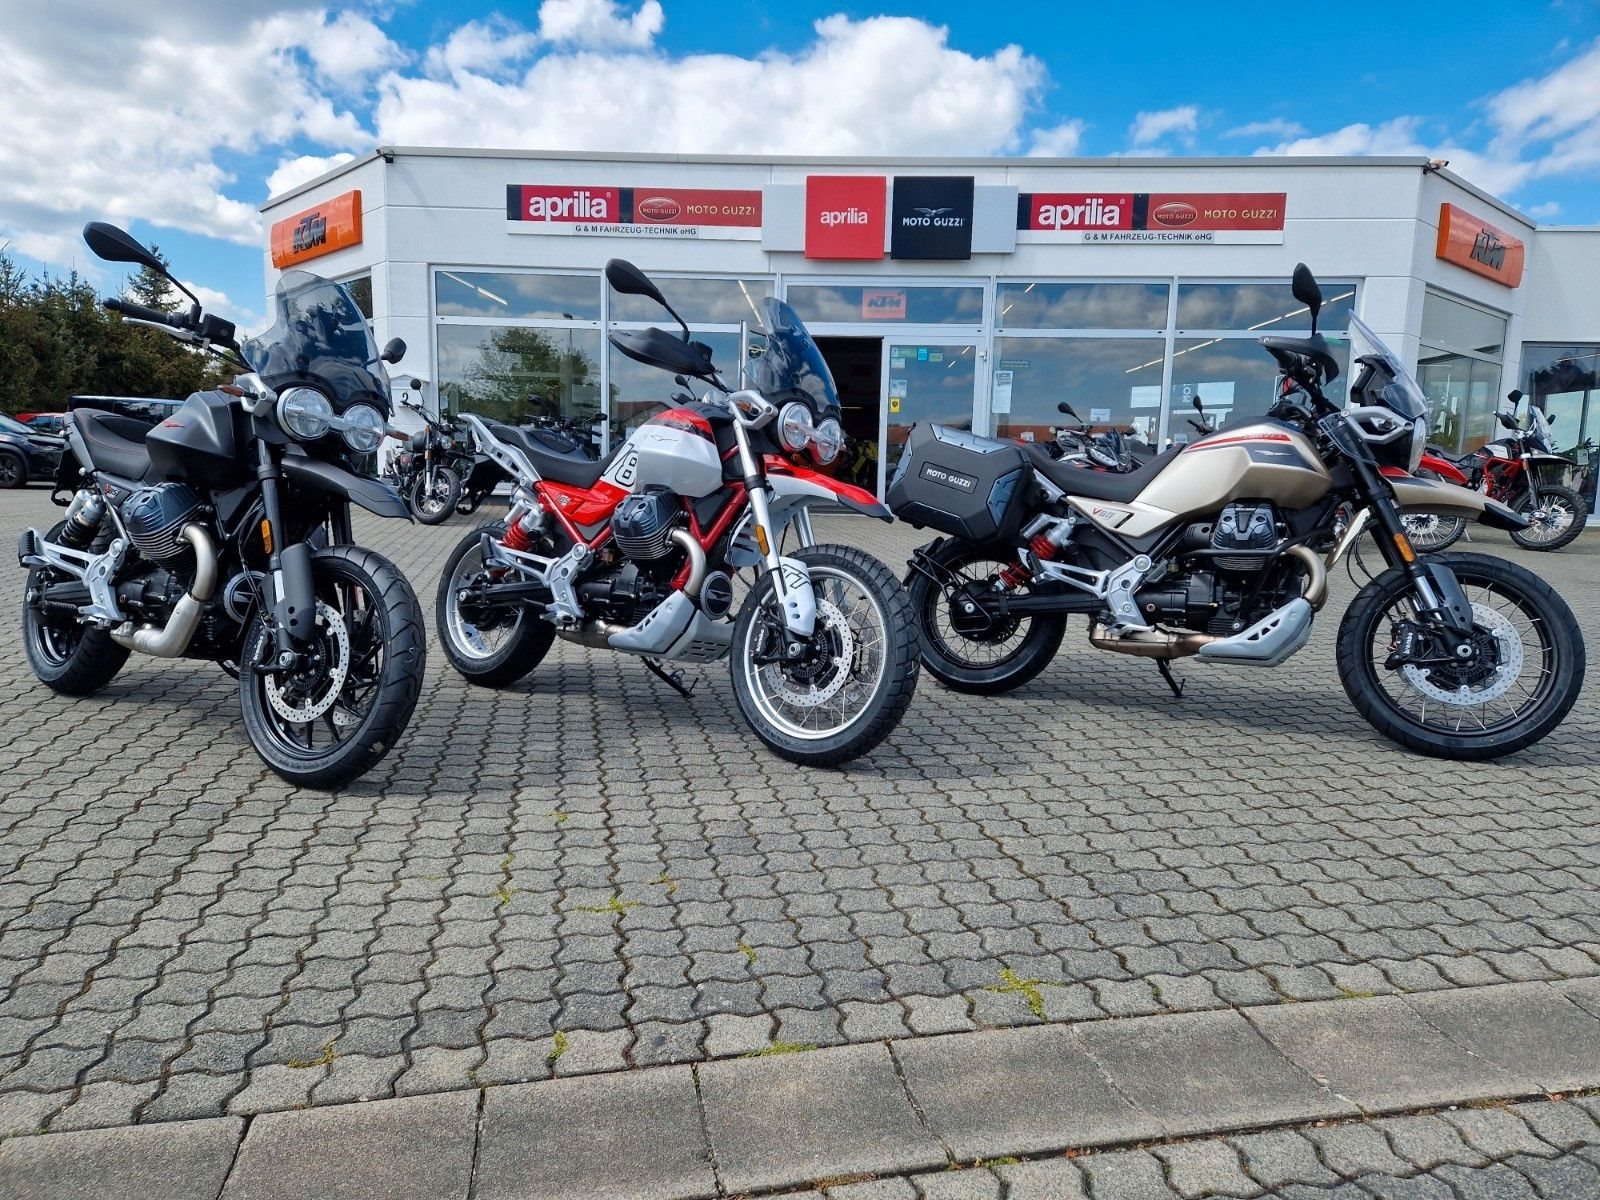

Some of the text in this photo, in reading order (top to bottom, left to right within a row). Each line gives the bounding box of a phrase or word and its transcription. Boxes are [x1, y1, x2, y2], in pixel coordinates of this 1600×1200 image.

[528, 191, 607, 221] aprilia
[686, 204, 755, 216] MOTO GUZZI
[1038, 198, 1120, 230] aprilia
[1204, 209, 1278, 219] MOTO GUZZI
[820, 207, 868, 227] aprilia
[902, 217, 963, 227] MOTO GUZZI
[293, 212, 327, 255] KTM
[591, 225, 598, 233] M
[599, 226, 678, 235] FAHRZEUG-TECHNIK
[1084, 233, 1091, 241] G
[1101, 233, 1108, 241] M
[1109, 233, 1193, 241] FAHRZEUG-TECHNIK
[1194, 233, 1212, 241] oHG
[1469, 228, 1506, 271] KTM
[926, 468, 971, 488] MOTO GUZZI
